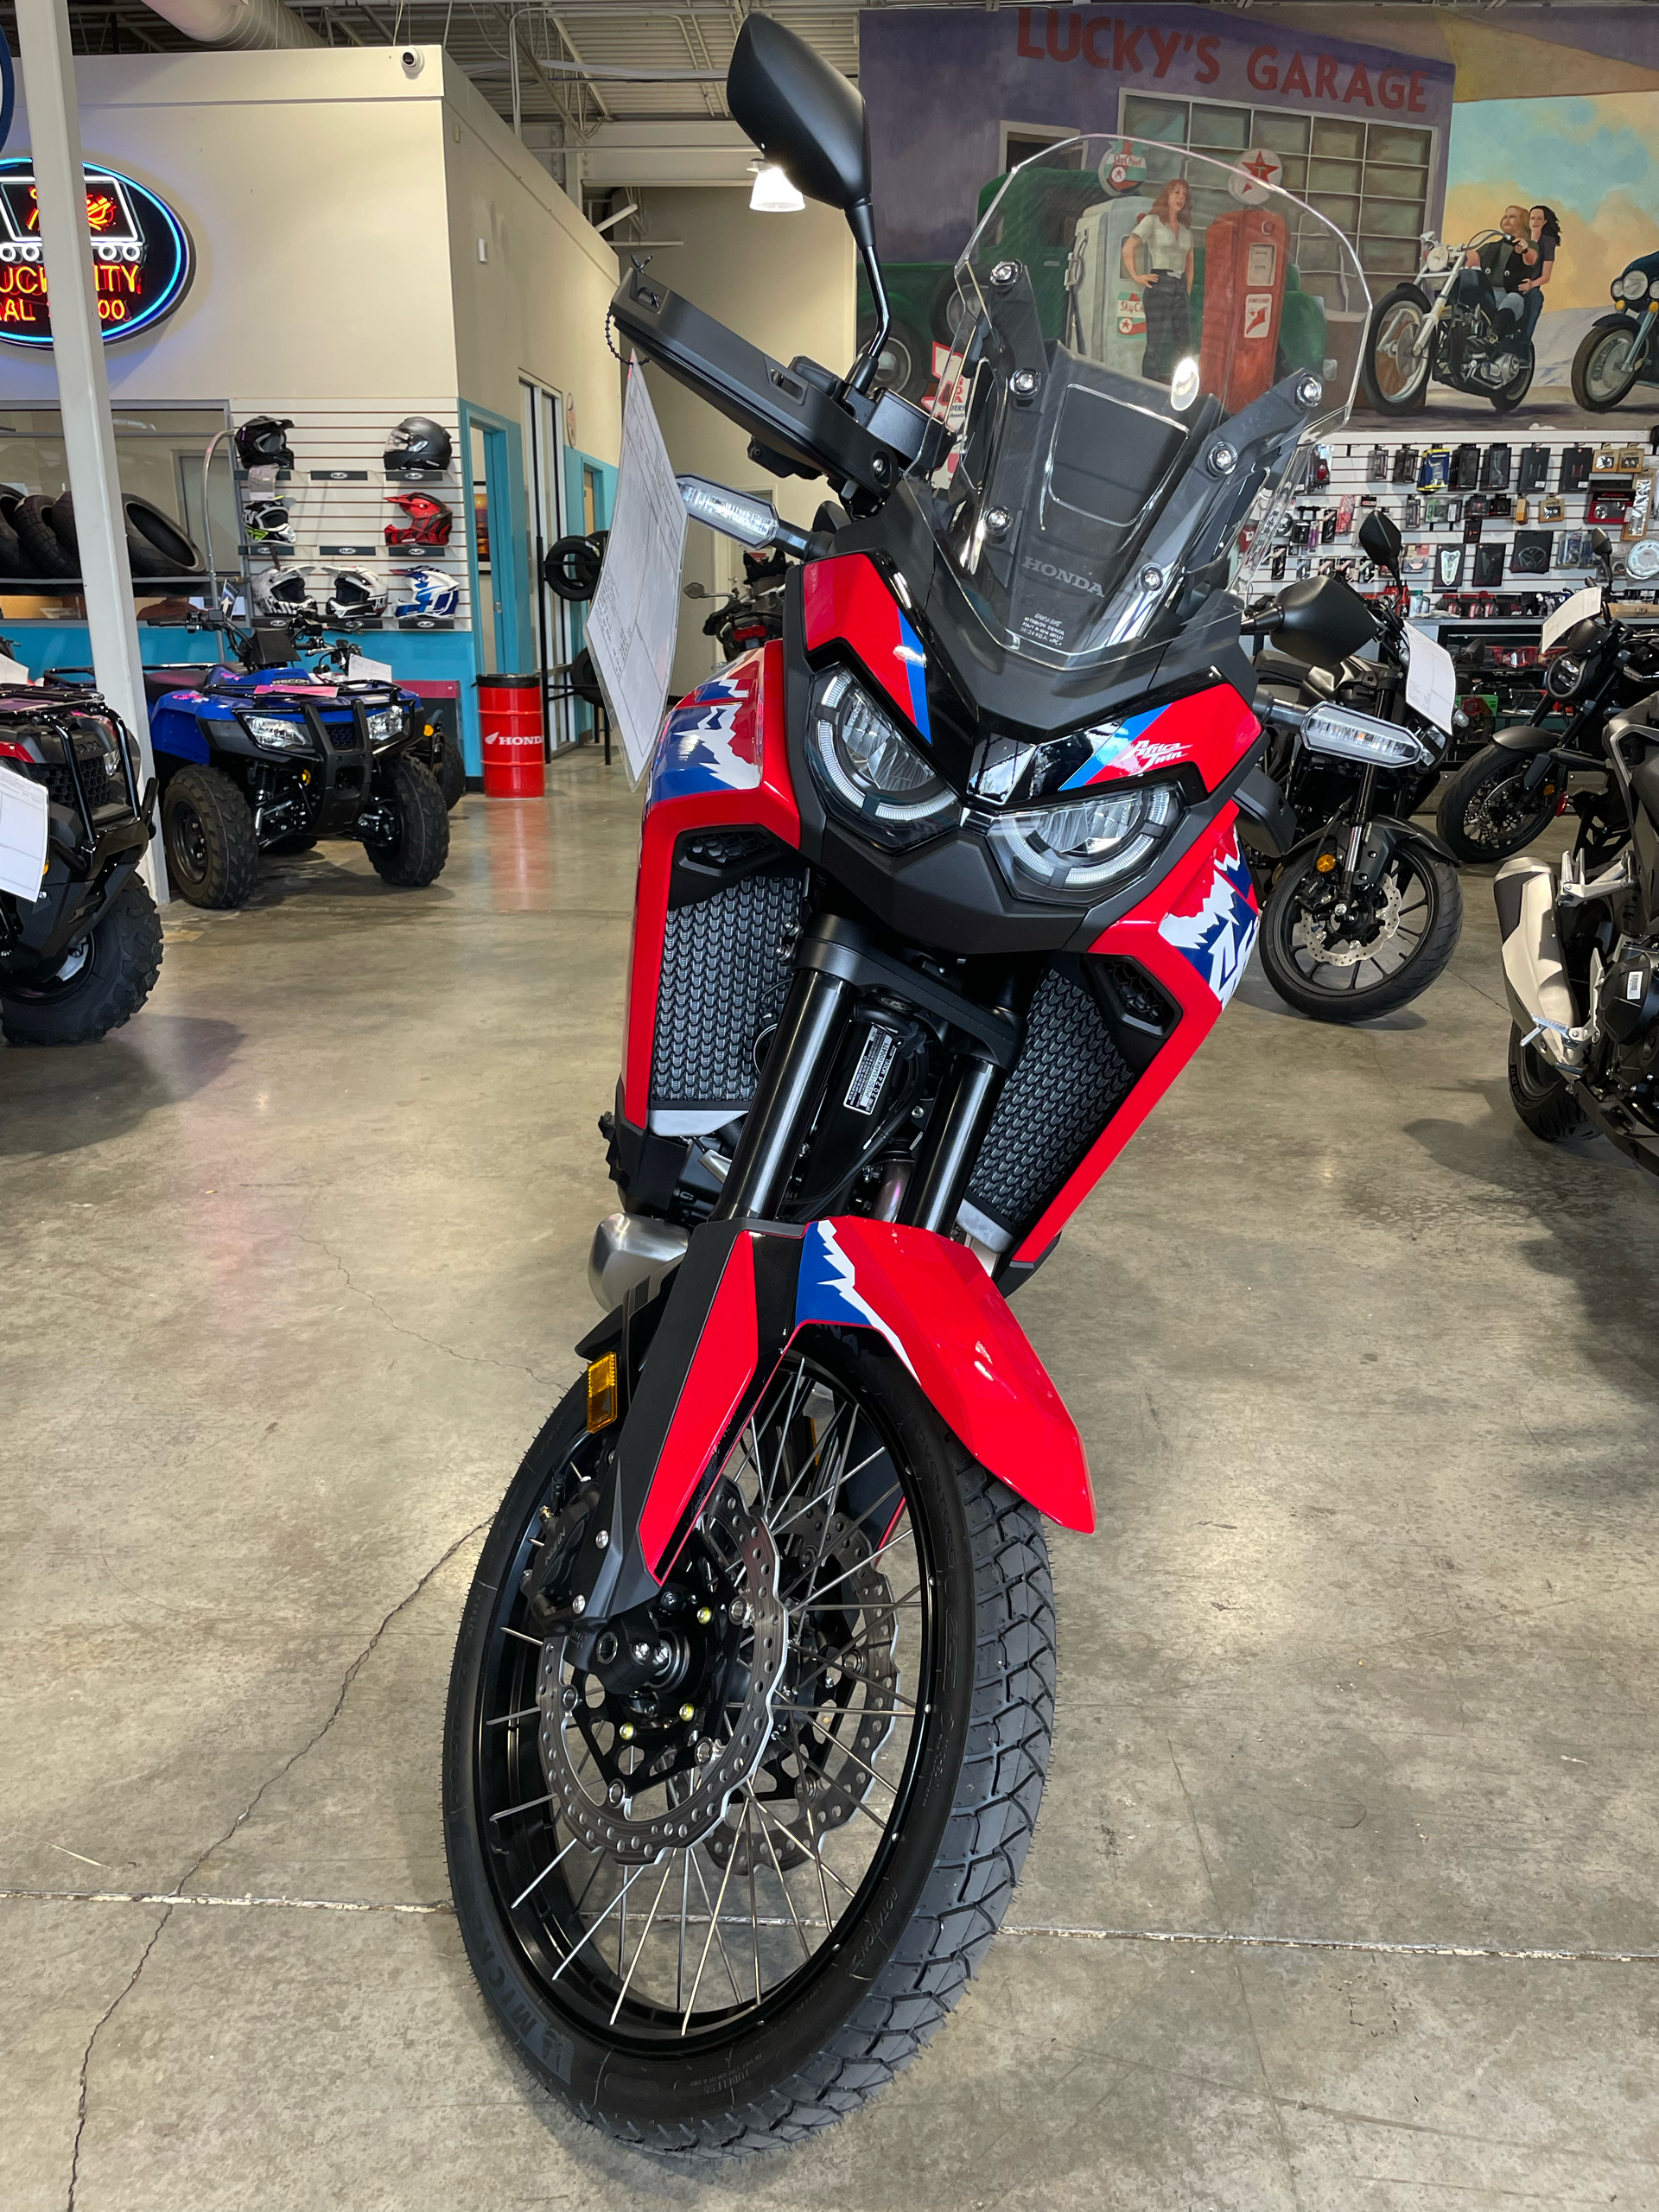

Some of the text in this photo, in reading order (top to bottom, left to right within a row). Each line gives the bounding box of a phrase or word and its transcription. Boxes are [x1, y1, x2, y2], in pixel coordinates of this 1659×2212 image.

[1017, 8, 1429, 113] LUCKY'S GARAGE
[93, 264, 139, 293] ITY
[1022, 556, 1104, 598] HONDA
[1120, 740, 1193, 761] Africa
[1128, 751, 1189, 776] Twin
[861, 1886, 899, 1957] ROTATION
[702, 2068, 751, 2094] TUBELESS
